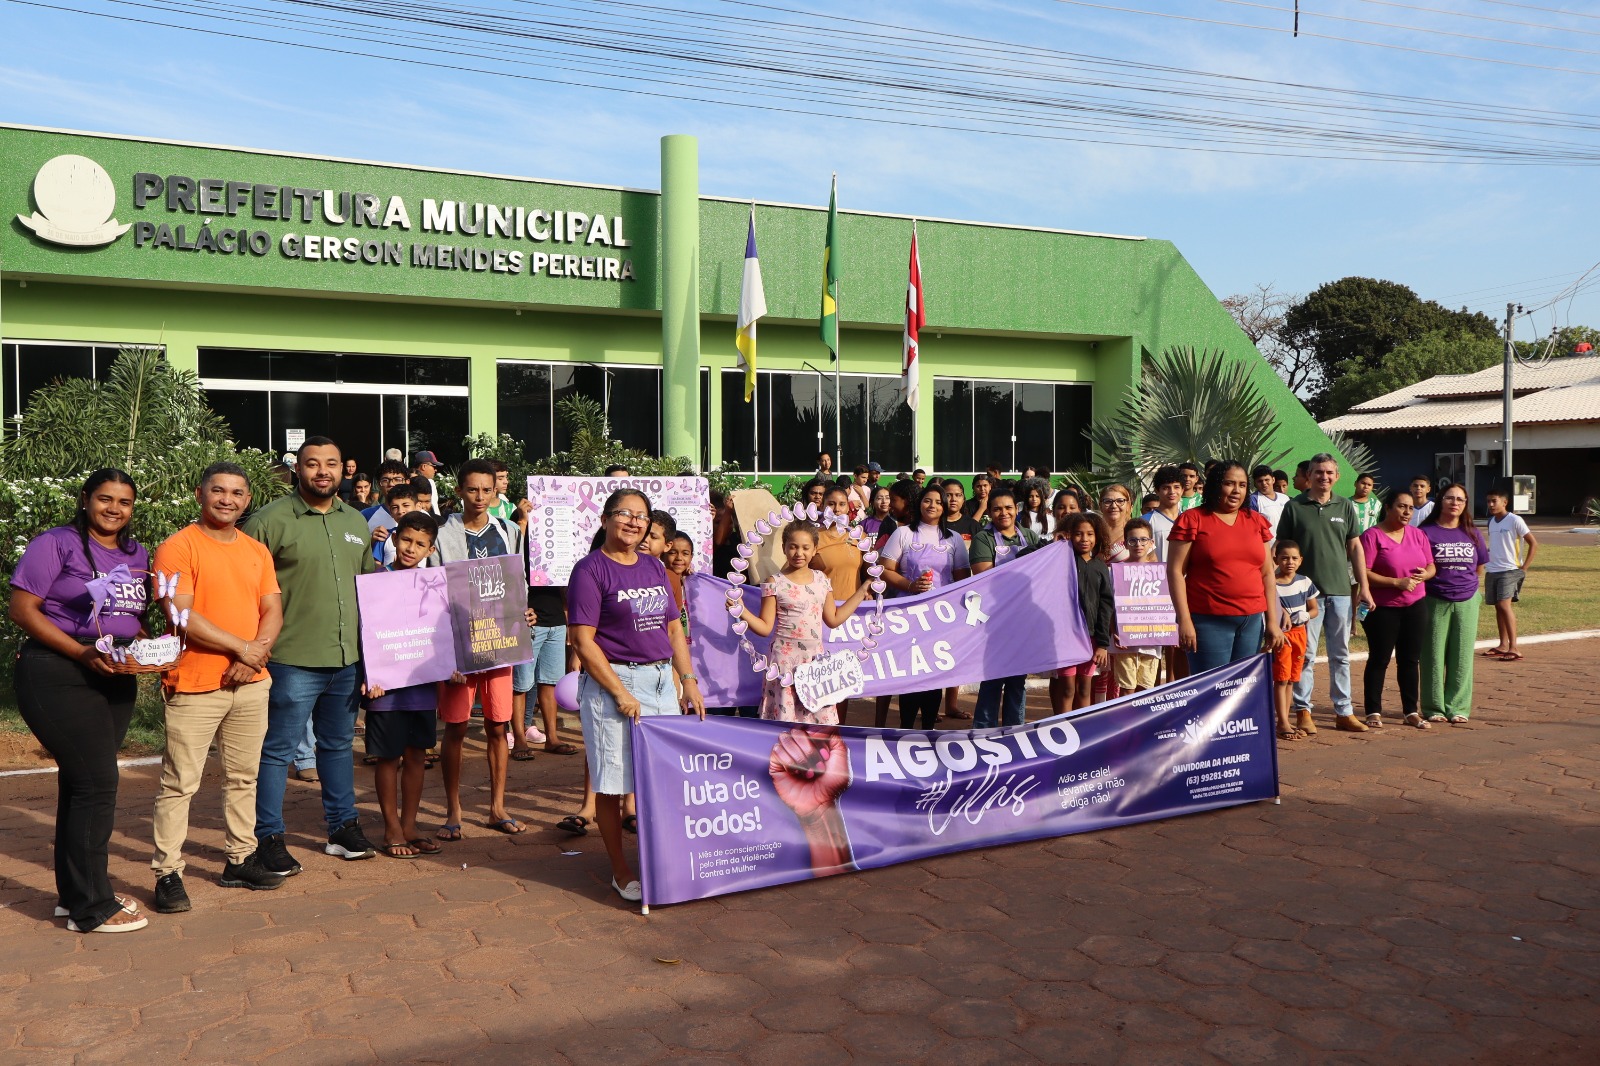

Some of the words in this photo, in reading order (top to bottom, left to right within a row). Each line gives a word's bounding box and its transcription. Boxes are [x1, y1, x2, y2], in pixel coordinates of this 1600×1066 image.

[133, 172, 411, 229] PREFEITURA
[422, 198, 631, 247] MUNICIPAL
[134, 217, 272, 255] PALÁCIO
[281, 233, 403, 263] GERSON
[413, 242, 524, 272] MENDES
[532, 251, 635, 280] PEREIRA
[595, 480, 662, 496] AGOSTO
[1435, 547, 1474, 557] ZERO
[469, 564, 503, 586] AGOSTO
[1123, 564, 1166, 581] AGOSTO
[115, 583, 147, 600] ERO
[479, 580, 505, 598] Lilás
[375, 629, 404, 640] Violência
[383, 640, 403, 651] rompa
[394, 651, 424, 661] Denuncie!
[807, 658, 845, 684] Agosto
[811, 670, 857, 699] LILÁS
[1132, 697, 1155, 708] CANAIS
[1165, 688, 1199, 701] DENÚNCIA
[1150, 702, 1174, 712] DISQUE
[1175, 699, 1187, 708] 180
[865, 719, 1081, 783] AGOSTO
[680, 752, 733, 773] uma
[1172, 761, 1211, 774] OUVIDORIA
[1212, 760, 1221, 768] DA
[1222, 753, 1250, 766] MULHER
[1058, 771, 1075, 785] Não
[1077, 772, 1088, 781] se
[1089, 765, 1111, 780] cale!
[1186, 775, 1200, 787] (63)
[1200, 768, 1240, 783] 99281-0574
[683, 779, 729, 806] luta
[732, 775, 760, 800] de
[1057, 782, 1095, 797] Levante
[1097, 782, 1103, 790] a
[1105, 777, 1125, 790] mão
[1061, 799, 1067, 809] e
[1069, 794, 1089, 809] diga
[1092, 790, 1111, 804] não!
[684, 805, 762, 839] todos!
[698, 850, 712, 860] Mês
[713, 848, 723, 857] de
[724, 841, 782, 856] conscientização
[699, 861, 714, 870] pelo
[715, 858, 729, 867] Fim
[729, 856, 740, 865] da
[741, 852, 775, 863] Violência
[699, 869, 725, 879] Contra
[731, 863, 757, 874] Mulher
